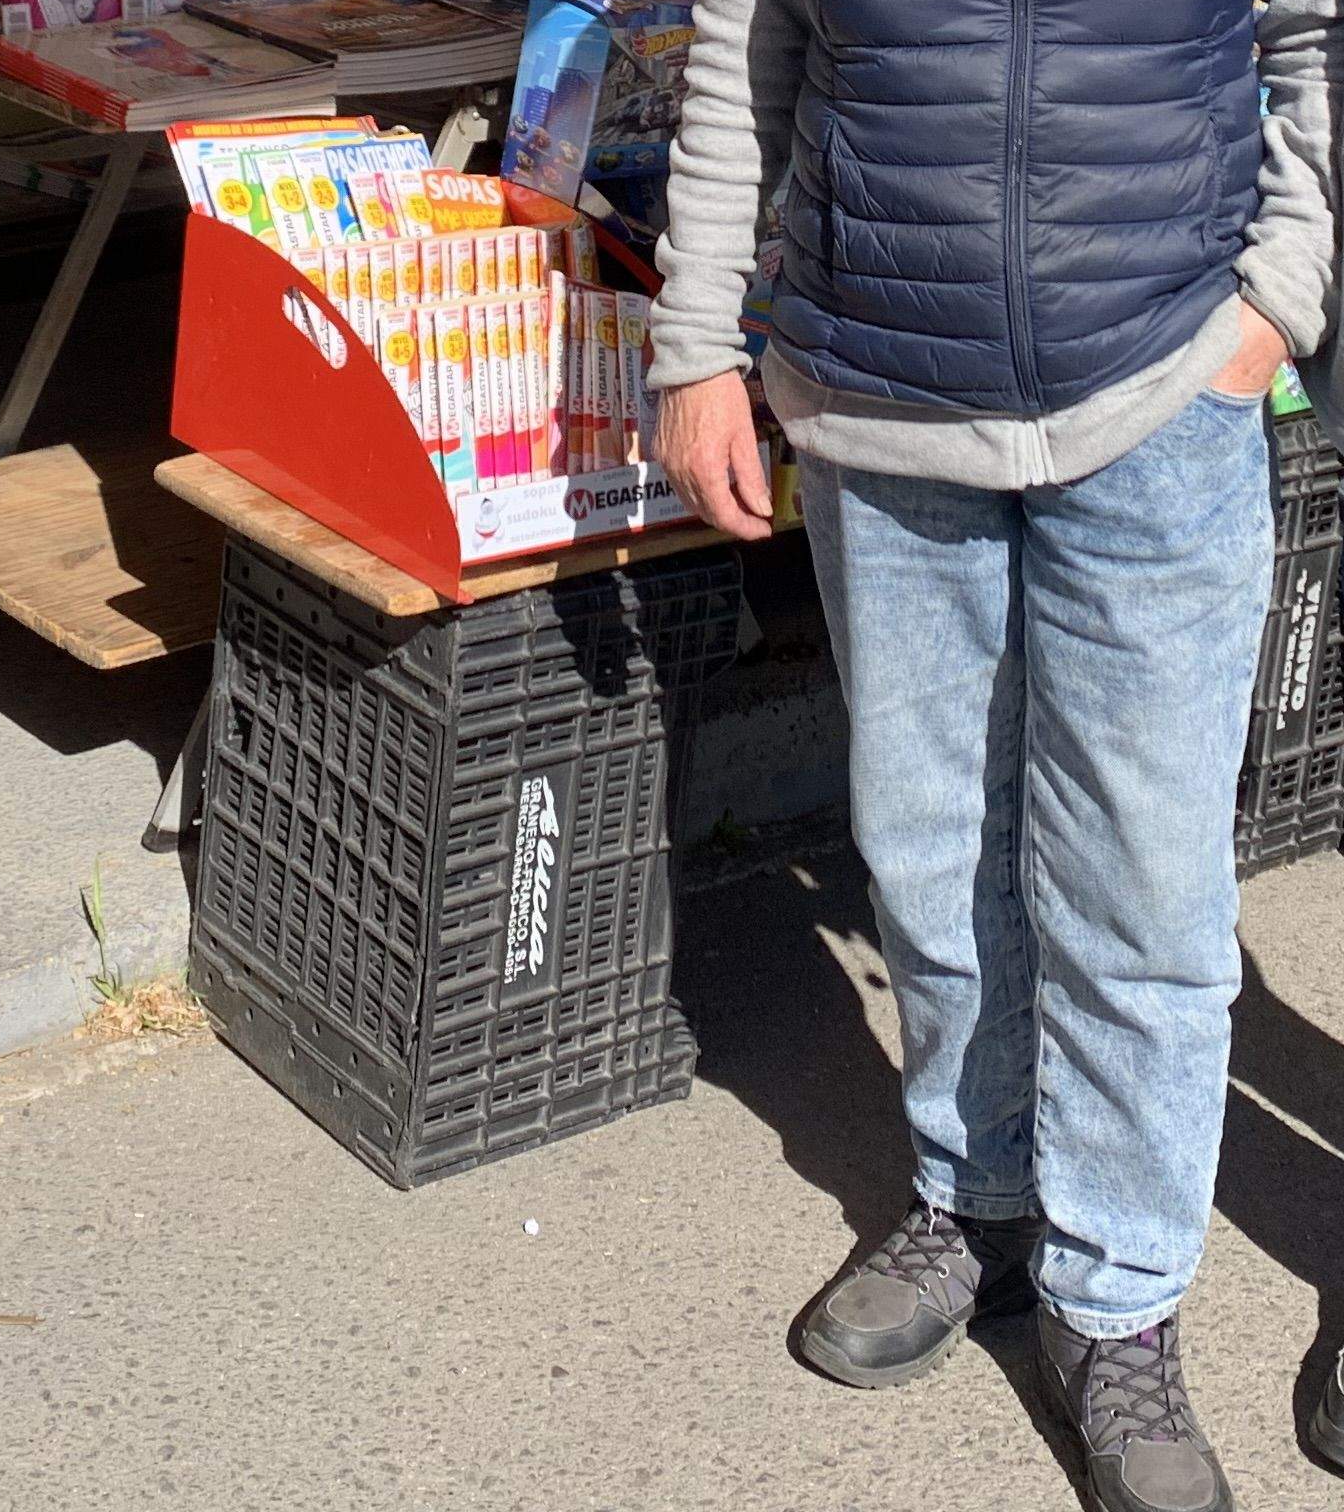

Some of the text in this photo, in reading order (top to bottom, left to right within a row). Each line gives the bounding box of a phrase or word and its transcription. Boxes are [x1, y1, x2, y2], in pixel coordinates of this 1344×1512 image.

[327, 140, 428, 180] PASATIEMPOS
[225, 194, 249, 210] 3-4
[282, 191, 304, 207] 1-2
[317, 190, 338, 206] 2-3
[426, 173, 503, 206] SOPAS
[392, 345, 411, 361] 4-5
[596, 346, 611, 416] MEGASTAR
[624, 347, 639, 416] MEGASTAR
[445, 364, 460, 436] MEGASTAR
[506, 502, 558, 527] sudoku
